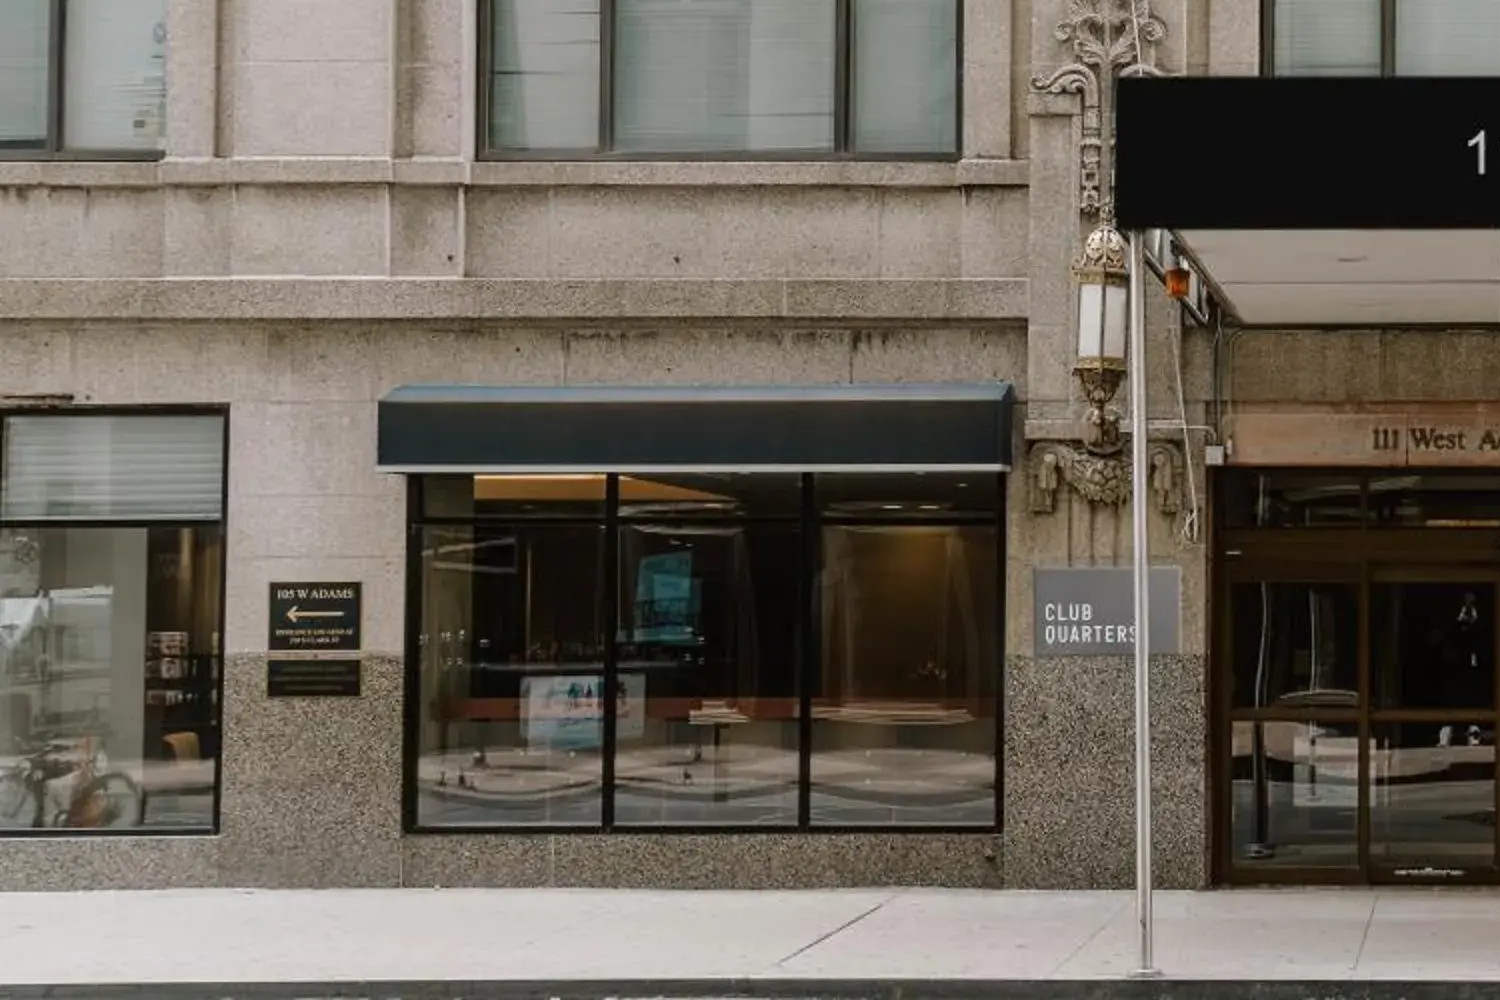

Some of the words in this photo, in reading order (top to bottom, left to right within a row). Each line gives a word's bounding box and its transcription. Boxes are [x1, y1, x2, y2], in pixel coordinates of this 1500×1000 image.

[1372, 428, 1399, 450] 111
[1408, 427, 1466, 450] West
[296, 588, 309, 600] W
[311, 588, 354, 600] ADAMS
[1045, 603, 1093, 621] CLUB
